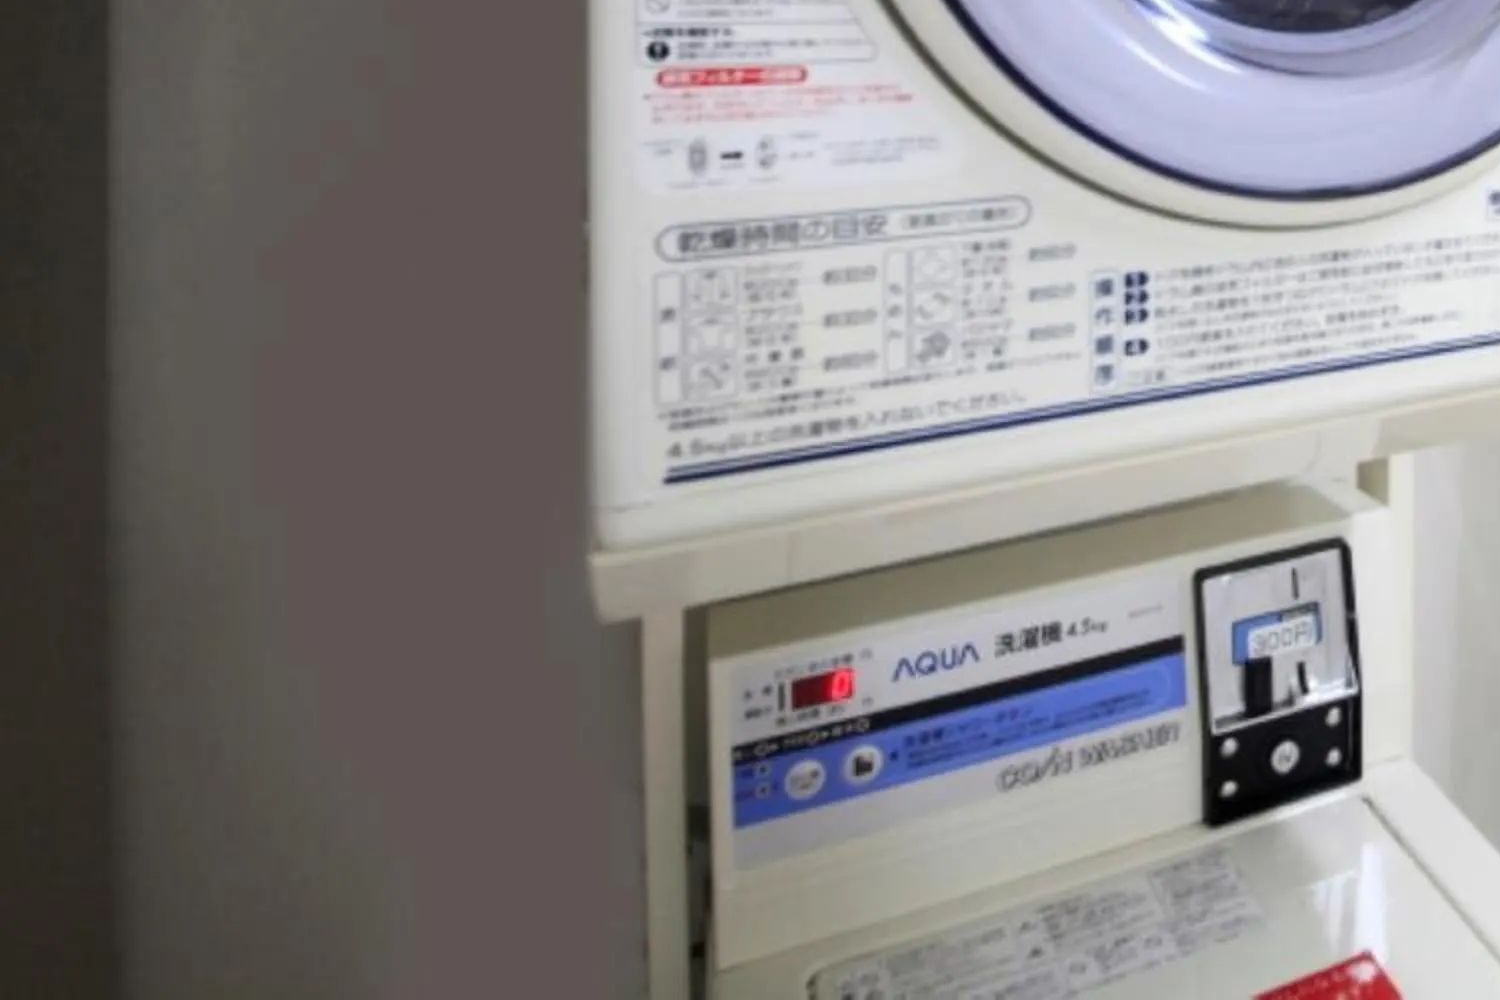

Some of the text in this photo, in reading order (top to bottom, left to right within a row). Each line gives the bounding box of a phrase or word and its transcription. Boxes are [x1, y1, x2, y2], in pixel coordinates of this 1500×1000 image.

[892, 641, 981, 683] AQUA
[994, 621, 1063, 658] 洗濯機
[831, 670, 851, 699] 0
